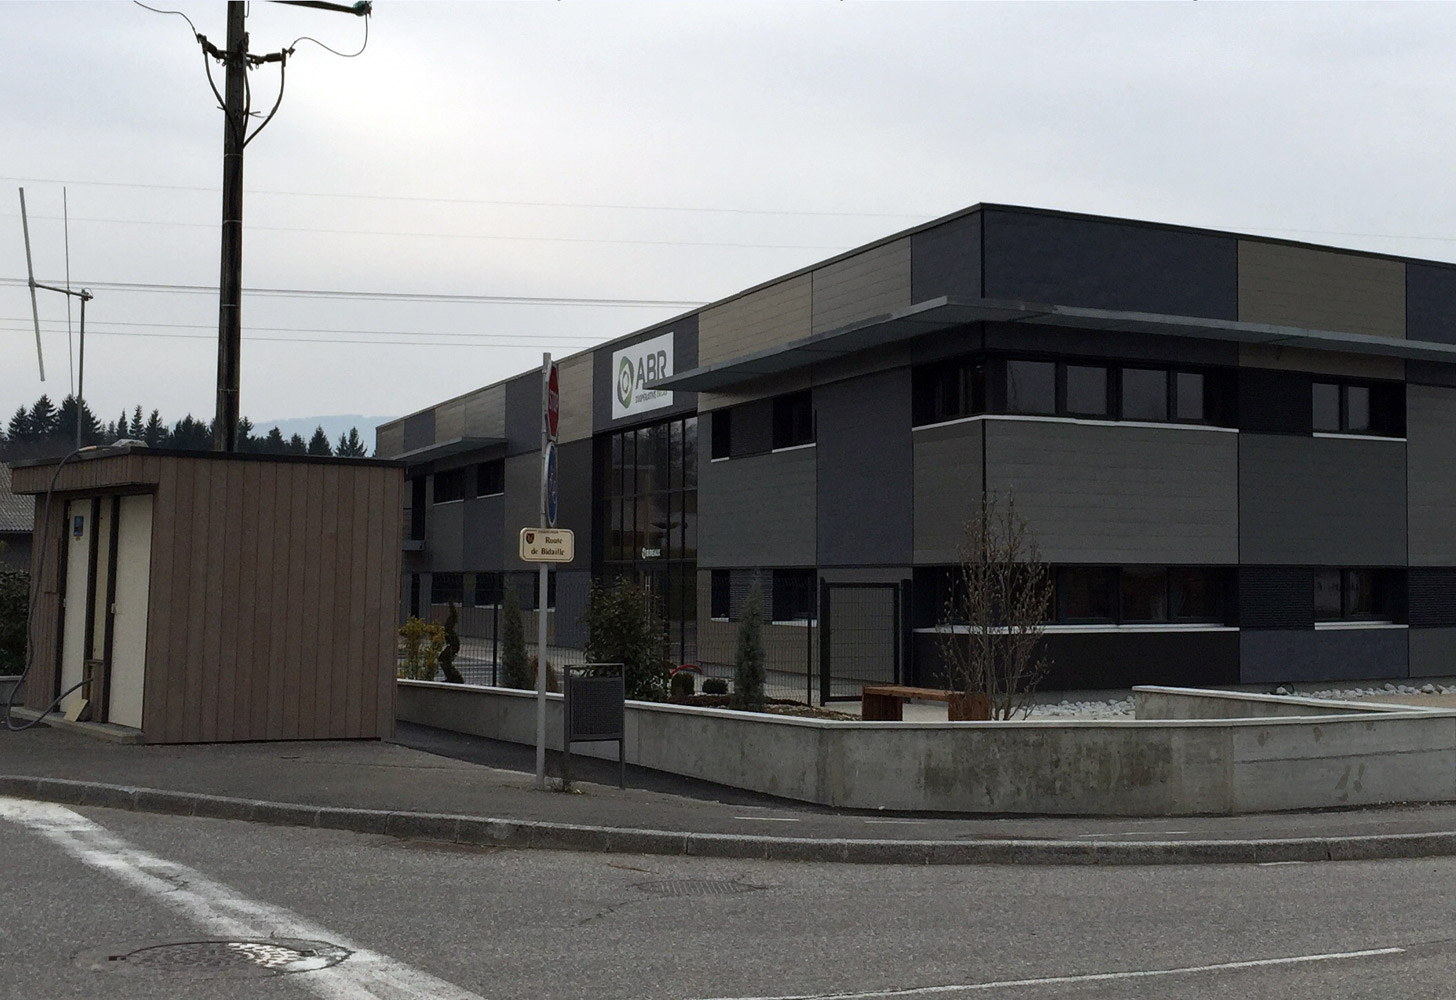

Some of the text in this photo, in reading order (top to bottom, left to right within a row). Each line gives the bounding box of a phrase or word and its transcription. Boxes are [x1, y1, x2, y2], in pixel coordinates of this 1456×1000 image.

[635, 350, 667, 390] ABR
[545, 536, 562, 544] Route
[530, 547, 538, 555] de
